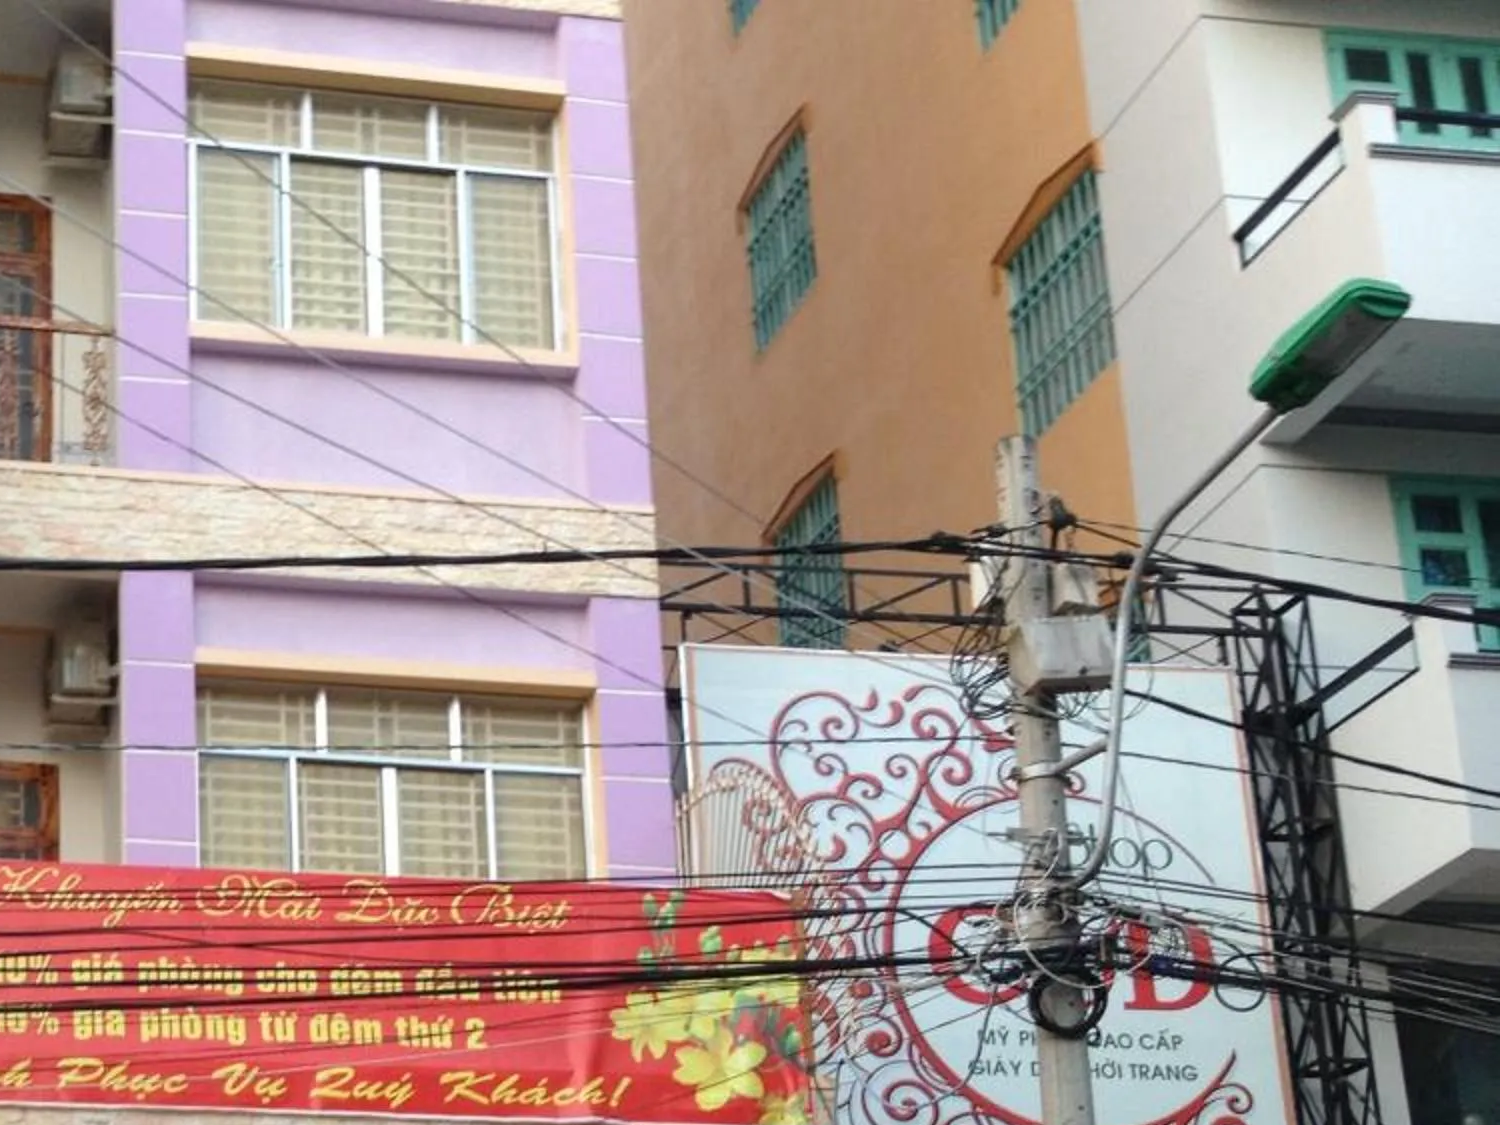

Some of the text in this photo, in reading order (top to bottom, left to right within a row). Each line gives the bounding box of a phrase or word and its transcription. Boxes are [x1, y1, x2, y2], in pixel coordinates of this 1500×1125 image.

[71, 953, 124, 990] giá
[137, 957, 244, 996] phòng
[140, 1006, 246, 1046] phòng
[259, 1010, 298, 1042] từ
[310, 1012, 383, 1045] đêm
[396, 1015, 454, 1049] thứ
[465, 1017, 488, 1049] 2
[1139, 1029, 1183, 1051] CẤP
[56, 1056, 190, 1100] Phục
[211, 1063, 288, 1105] Vụ
[308, 1066, 414, 1109] Quý
[439, 1070, 632, 1108] Khách!
[1088, 1059, 1123, 1080] HỜI
[1130, 1063, 1199, 1082] TRANG
